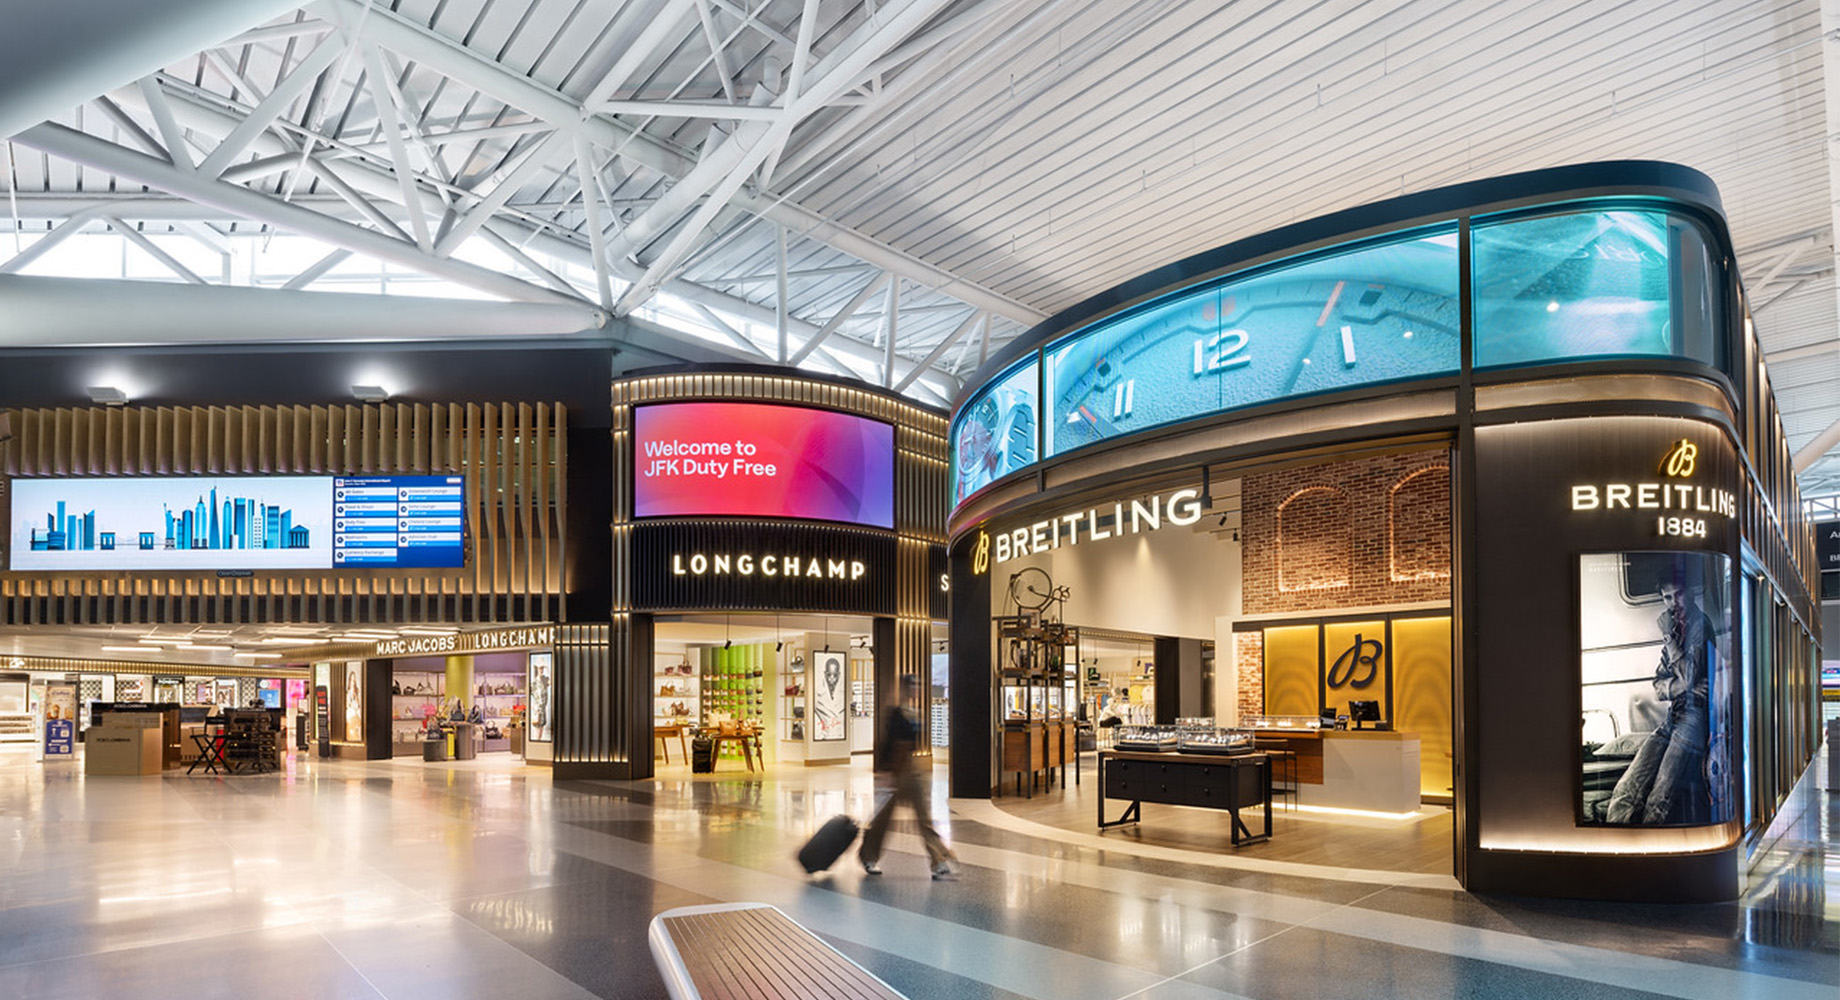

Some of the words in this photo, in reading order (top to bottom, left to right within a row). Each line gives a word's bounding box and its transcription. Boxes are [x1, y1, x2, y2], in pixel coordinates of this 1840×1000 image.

[1193, 329, 1250, 378] 12
[644, 440, 731, 457] Welcome
[735, 440, 756, 456] to
[644, 459, 679, 477] JFK
[683, 459, 728, 478] Duty
[733, 459, 776, 476] Free
[1571, 483, 1736, 519] BREITLING
[996, 489, 1202, 563] BREITLING
[1658, 516, 1706, 538] 1884
[673, 554, 865, 580] LONGCHAMP
[376, 640, 406, 655] MARC
[407, 636, 455, 653] JACOBS
